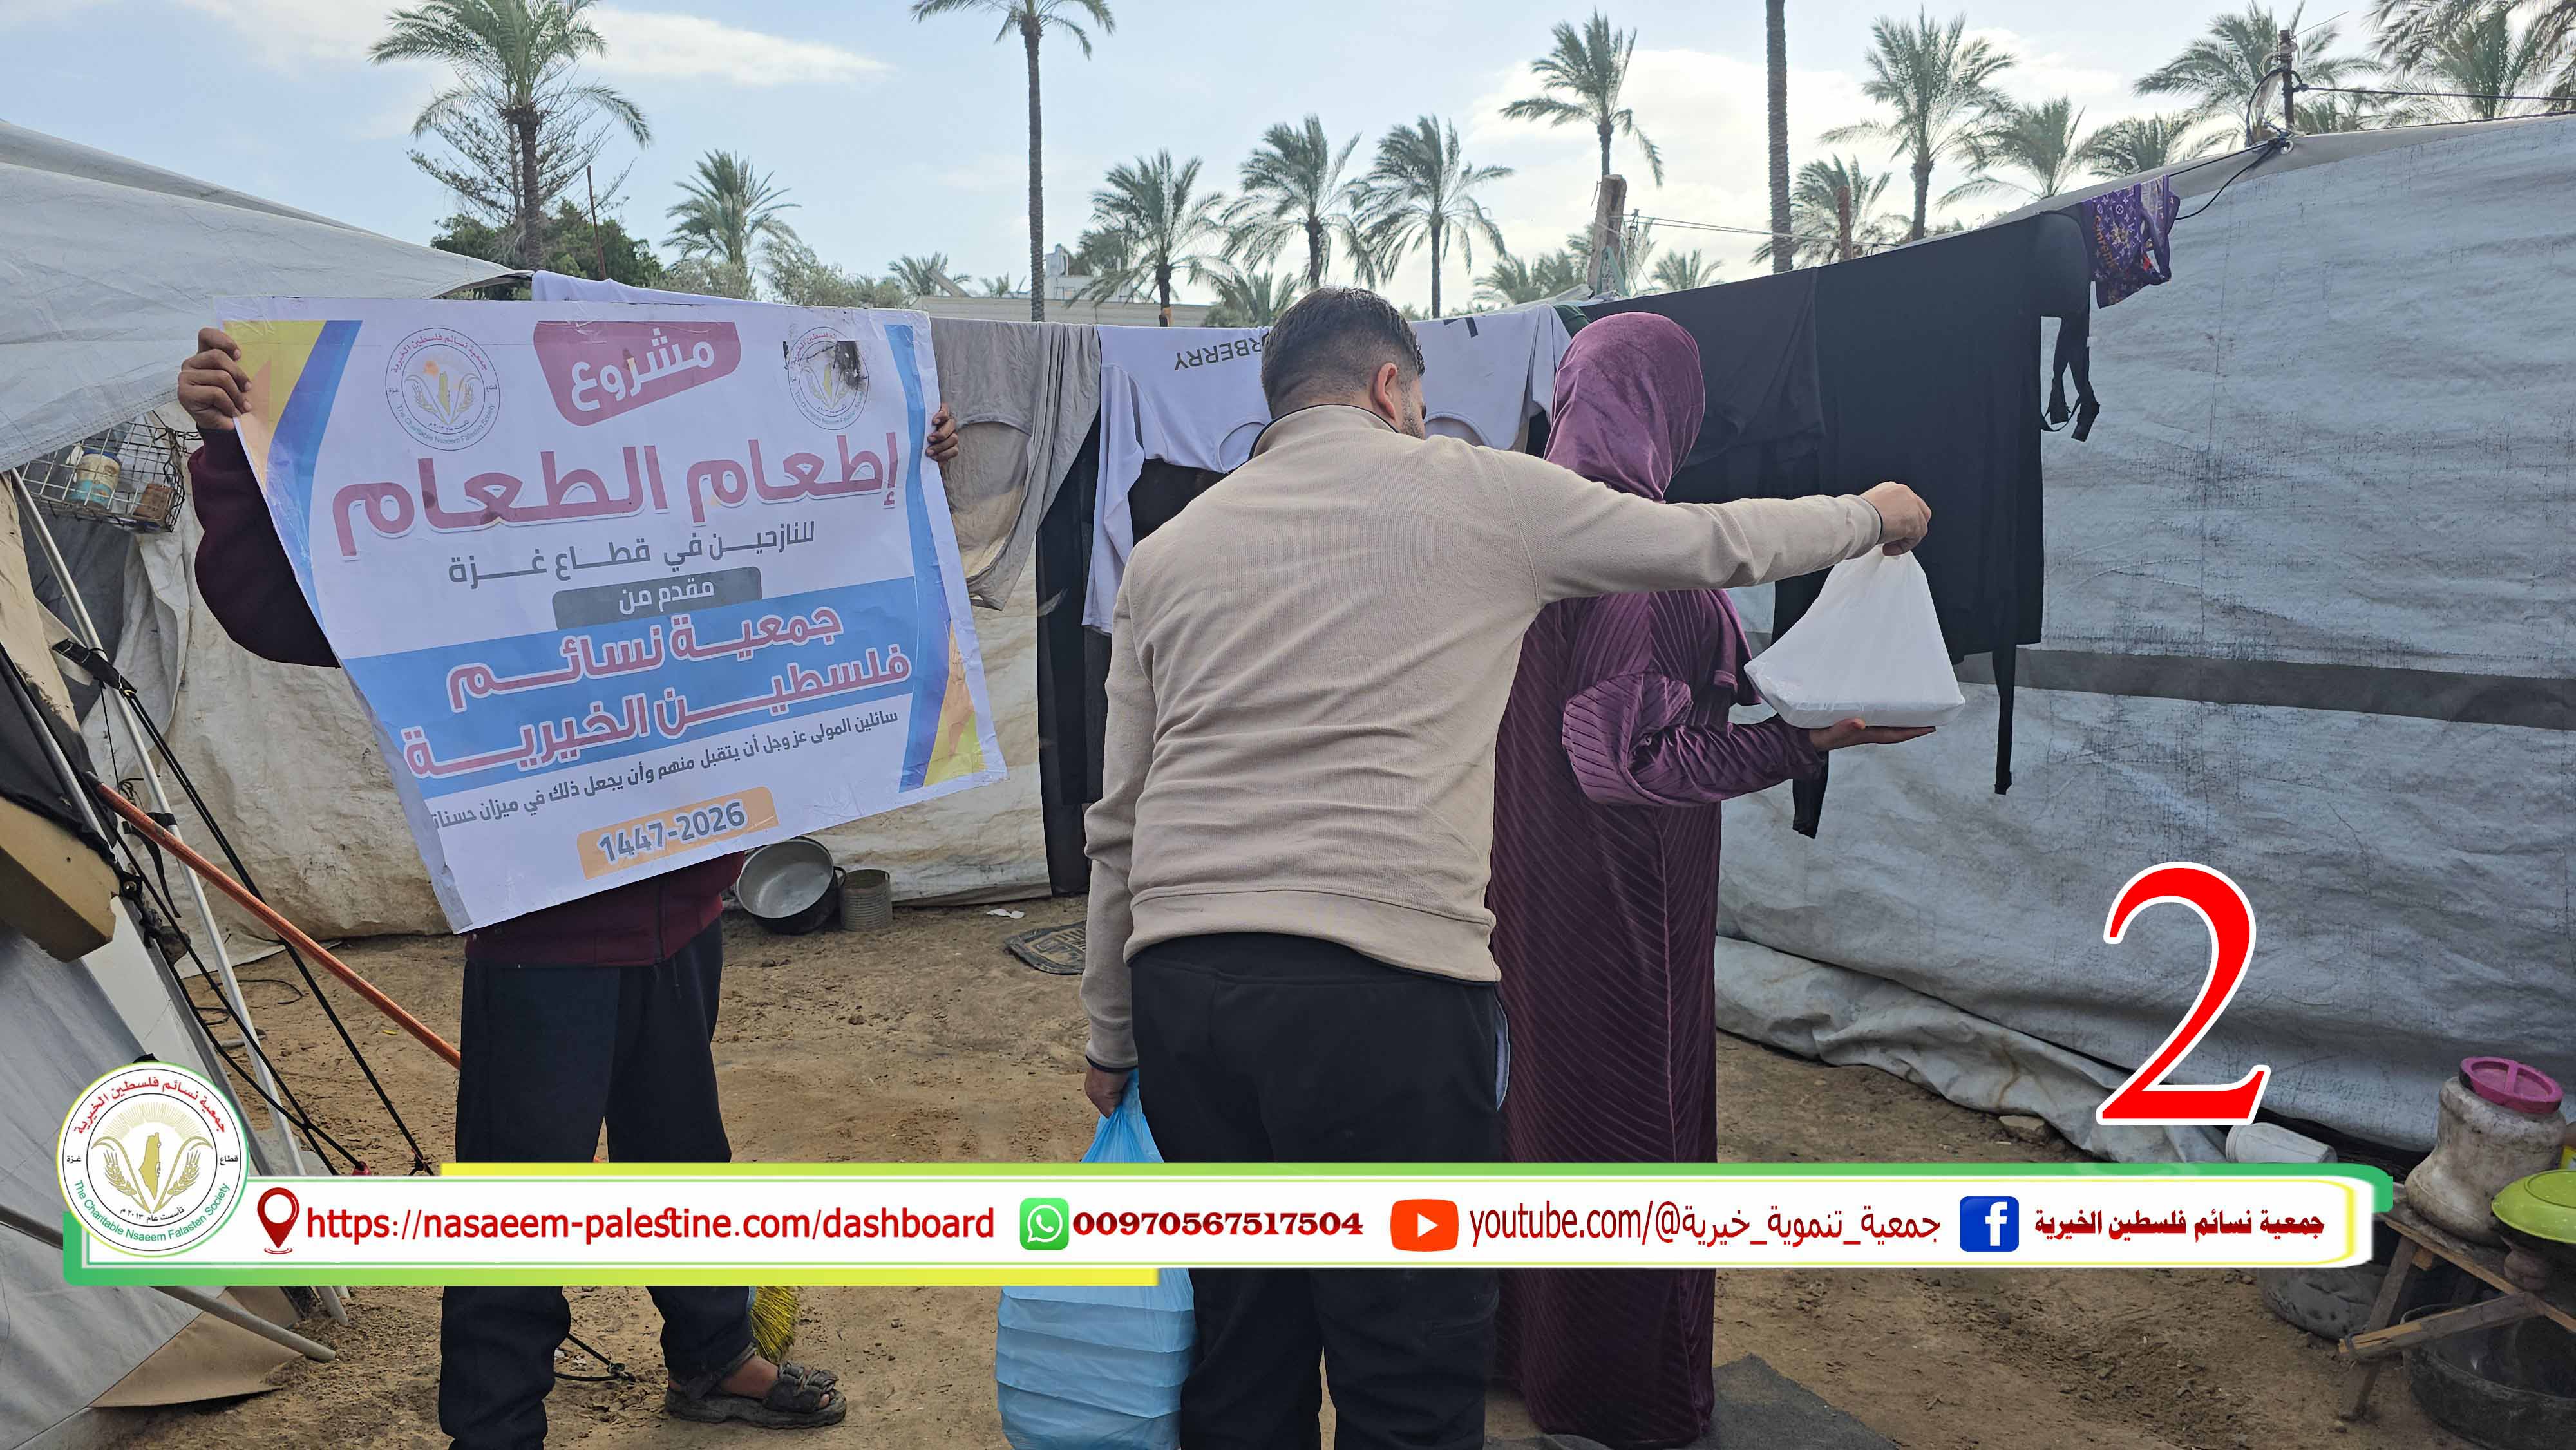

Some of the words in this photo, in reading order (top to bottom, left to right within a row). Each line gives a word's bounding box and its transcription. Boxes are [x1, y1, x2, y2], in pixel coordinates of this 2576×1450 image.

[571, 328, 715, 411] مشروع
[687, 432, 898, 526] إطعام
[333, 445, 668, 561] الطعام
[664, 532, 702, 572] في
[709, 520, 815, 560] للنازحين
[449, 549, 547, 590] غزة
[555, 538, 650, 581] قطاع
[619, 587, 652, 614] من
[658, 578, 715, 612] مقدم
[670, 607, 843, 662] جمعية
[447, 625, 664, 713] نسائم
[654, 643, 913, 739] فلسطين
[401, 693, 650, 779] الخيرية
[810, 718, 851, 742] المولى
[855, 710, 898, 733] سائلين
[743, 736, 761, 758] أن
[762, 734, 791, 755] وجل
[793, 728, 808, 749] عز
[658, 756, 694, 779] منهم
[700, 744, 741, 770] يتقبل
[583, 773, 625, 798] يجعل
[627, 761, 655, 784] وأن
[524, 789, 545, 816] في
[549, 780, 580, 801] ذلك
[479, 797, 520, 821] ميزان
[598, 802, 746, 862] 1447-2026
